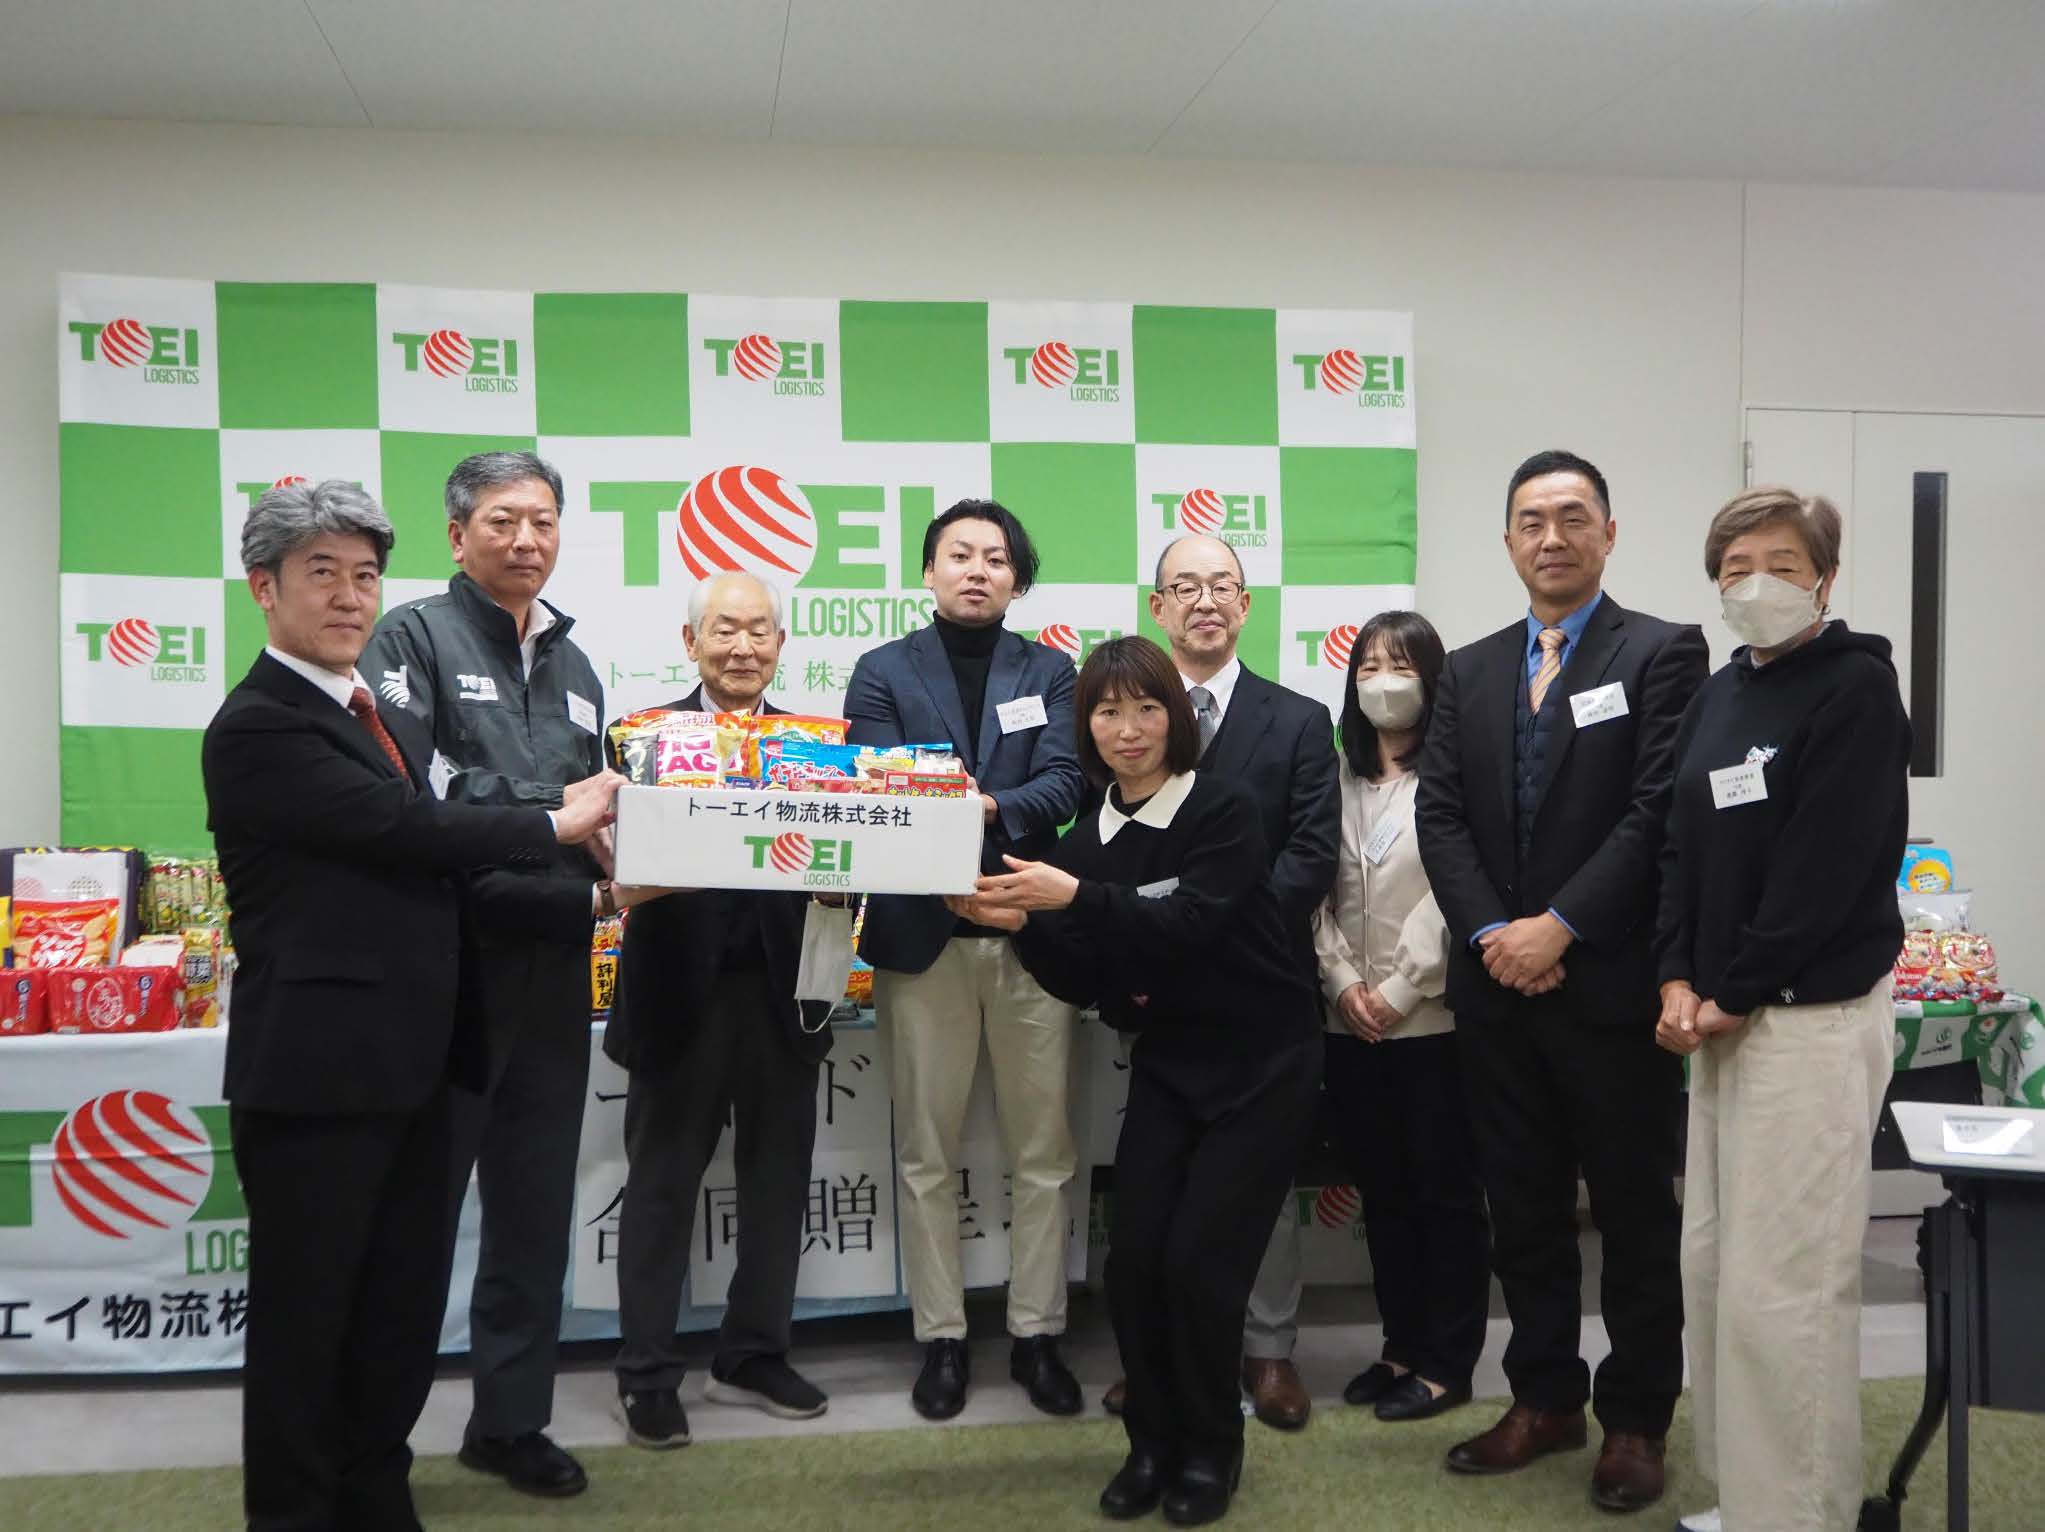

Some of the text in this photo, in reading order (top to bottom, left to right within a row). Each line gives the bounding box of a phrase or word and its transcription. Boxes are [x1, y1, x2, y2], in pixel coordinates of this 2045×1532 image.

[144, 367, 199, 385] LOGISTICS
[465, 377, 518, 393] LOGISTICS
[774, 380, 825, 396] LOGISTICS
[1070, 386, 1119, 402] LOGISTICS
[1358, 393, 1405, 408] LOGISTICS
[791, 597, 936, 638] LOGISTICS
[151, 665, 206, 682] LOGISTICS
[689, 797, 913, 828] トーエイ物流株式会社
[803, 873, 851, 887] LOGISTICS
